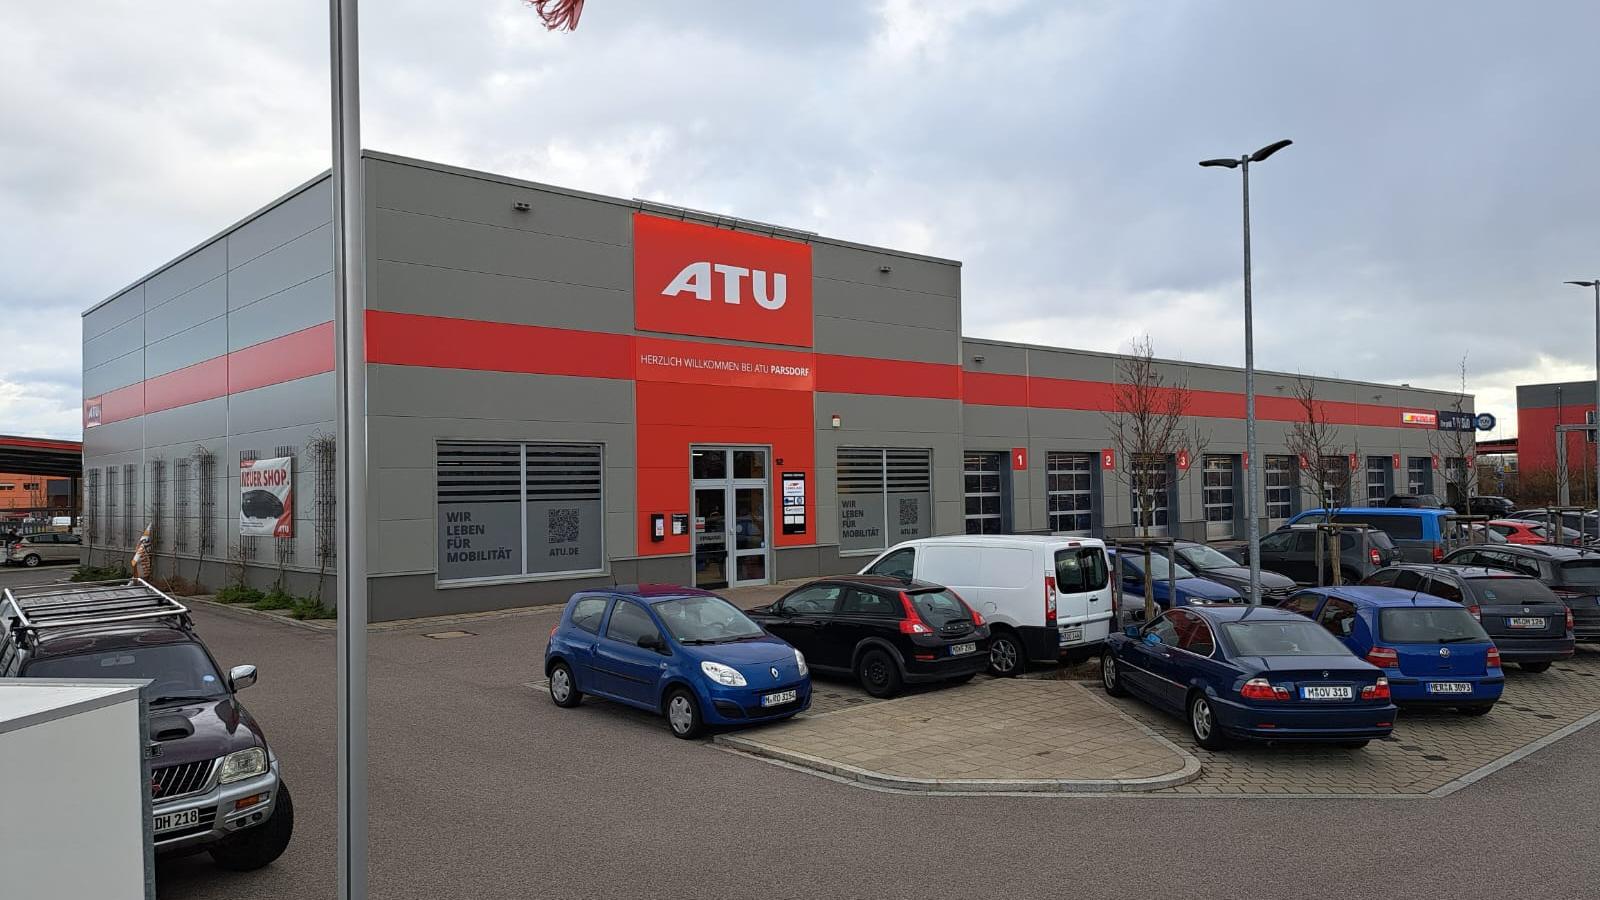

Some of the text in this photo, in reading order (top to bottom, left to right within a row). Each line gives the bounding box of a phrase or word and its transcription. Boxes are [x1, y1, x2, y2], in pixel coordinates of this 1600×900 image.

[661, 261, 787, 311] ATU
[640, 354, 810, 377] HERZLICH WILLKOMMEN BEI ATU PARSDORF
[1017, 454, 1023, 466] 1
[1105, 455, 1112, 466] 2
[1180, 456, 1186, 466] 3
[241, 470, 262, 487] NEUER
[841, 500, 856, 508] WIR
[447, 511, 472, 523] WIR
[842, 509, 864, 518] LEBEN
[447, 524, 485, 536] LEBEN
[842, 526, 880, 538] MOBILITÄT
[447, 536, 471, 549] FÜR
[447, 546, 512, 563] MOBILITÄT
[549, 547, 579, 557] ATU.DE
[1332, 687, 1349, 697] 318
[174, 810, 198, 826] 218
